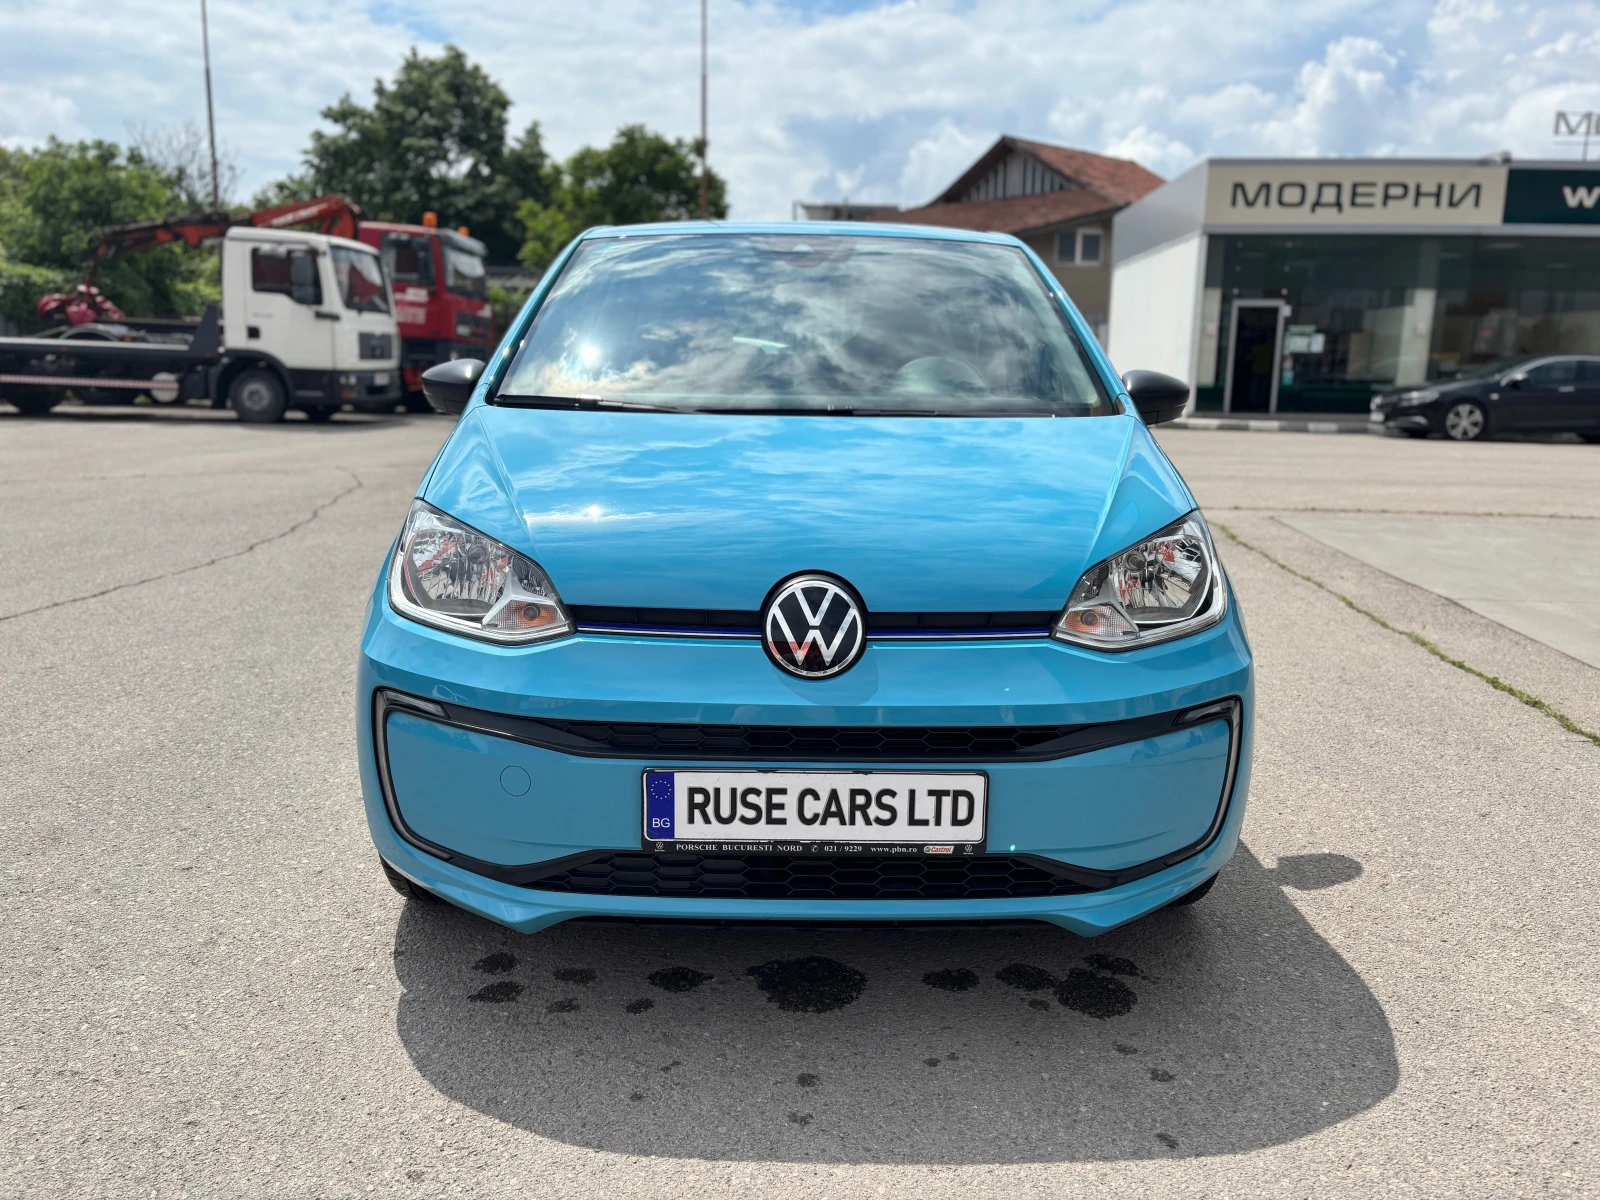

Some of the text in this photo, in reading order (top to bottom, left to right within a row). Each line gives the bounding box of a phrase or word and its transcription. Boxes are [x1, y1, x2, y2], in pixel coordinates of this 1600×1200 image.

[1231, 181, 1483, 214] МОДЕРНИ
[687, 786, 976, 827] RUSE CARS LTD
[652, 817, 671, 828] BG
[676, 843, 718, 851] PORSCHE
[777, 844, 803, 852] NORD
[871, 845, 918, 854] www.pbn.ro
